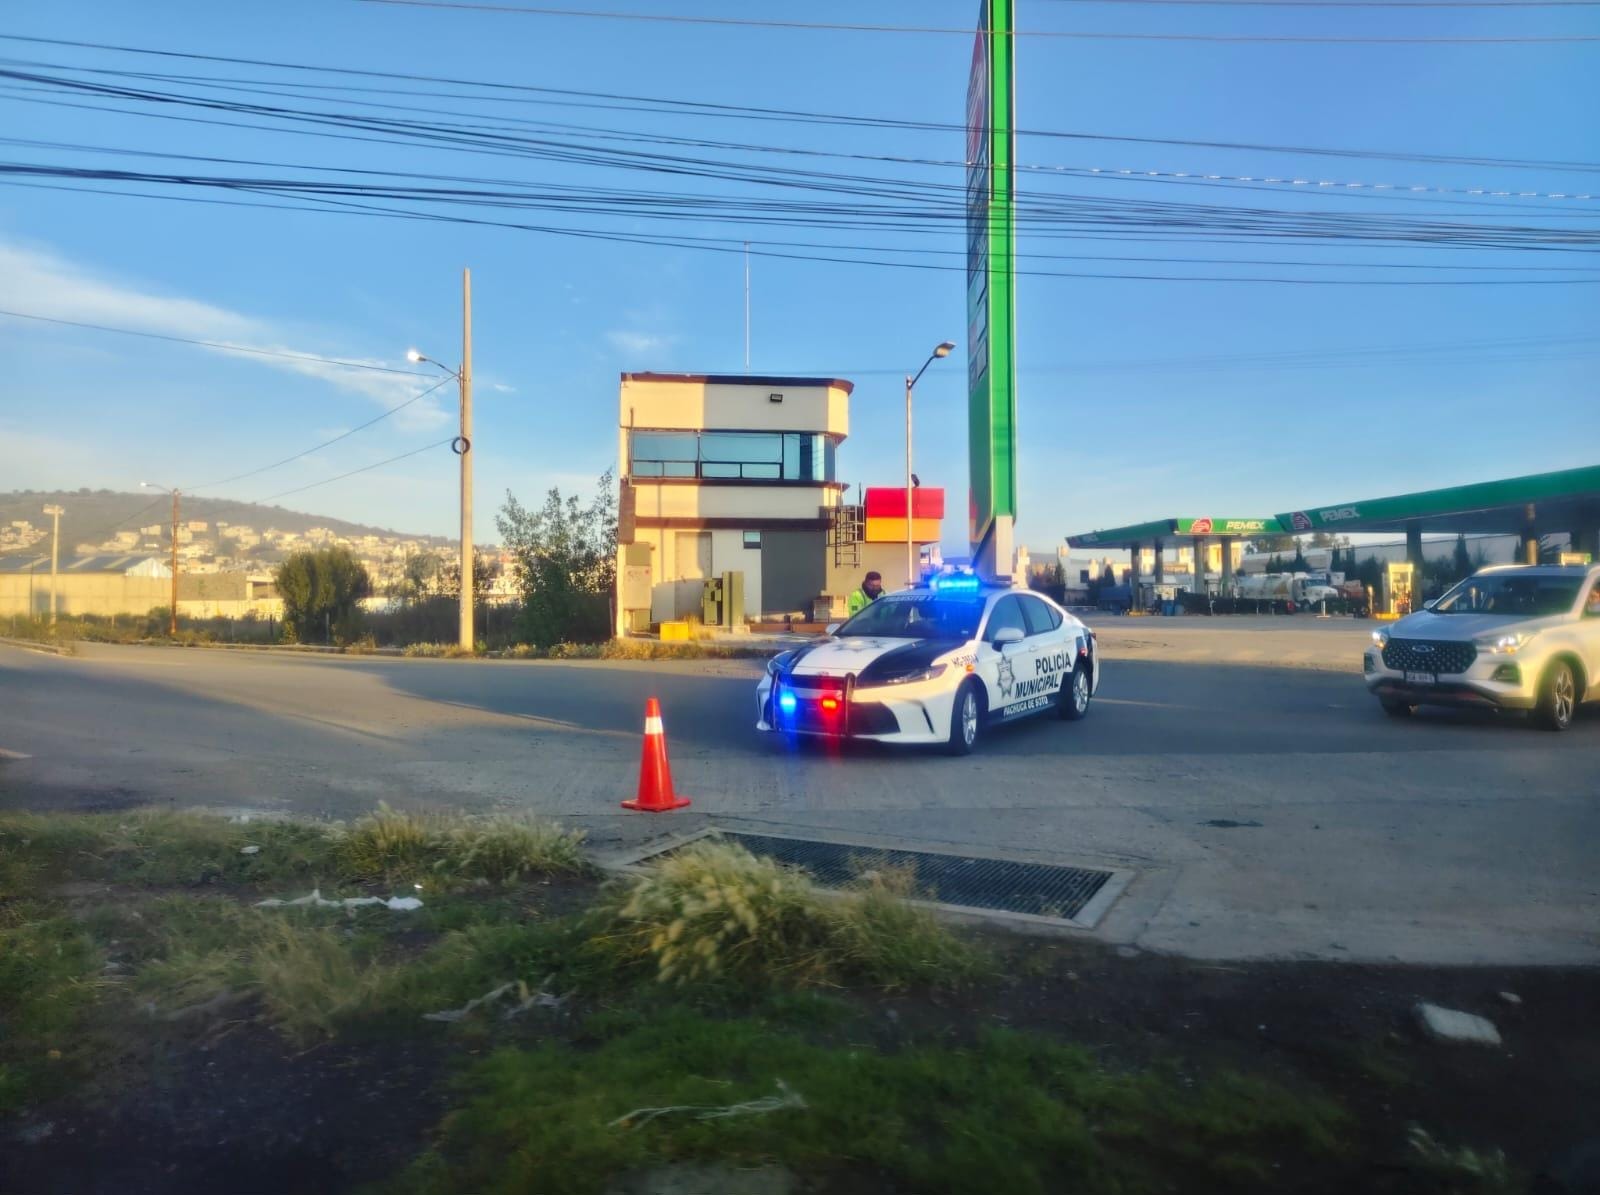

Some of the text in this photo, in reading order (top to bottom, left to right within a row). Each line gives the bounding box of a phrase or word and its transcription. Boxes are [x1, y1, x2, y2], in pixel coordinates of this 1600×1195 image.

[1319, 507, 1360, 522] PEMEX
[1226, 520, 1265, 530] PEMEX
[1015, 673, 1059, 699] MUNICIPAL
[1003, 695, 1049, 718] PACHUCA DE SOTO
